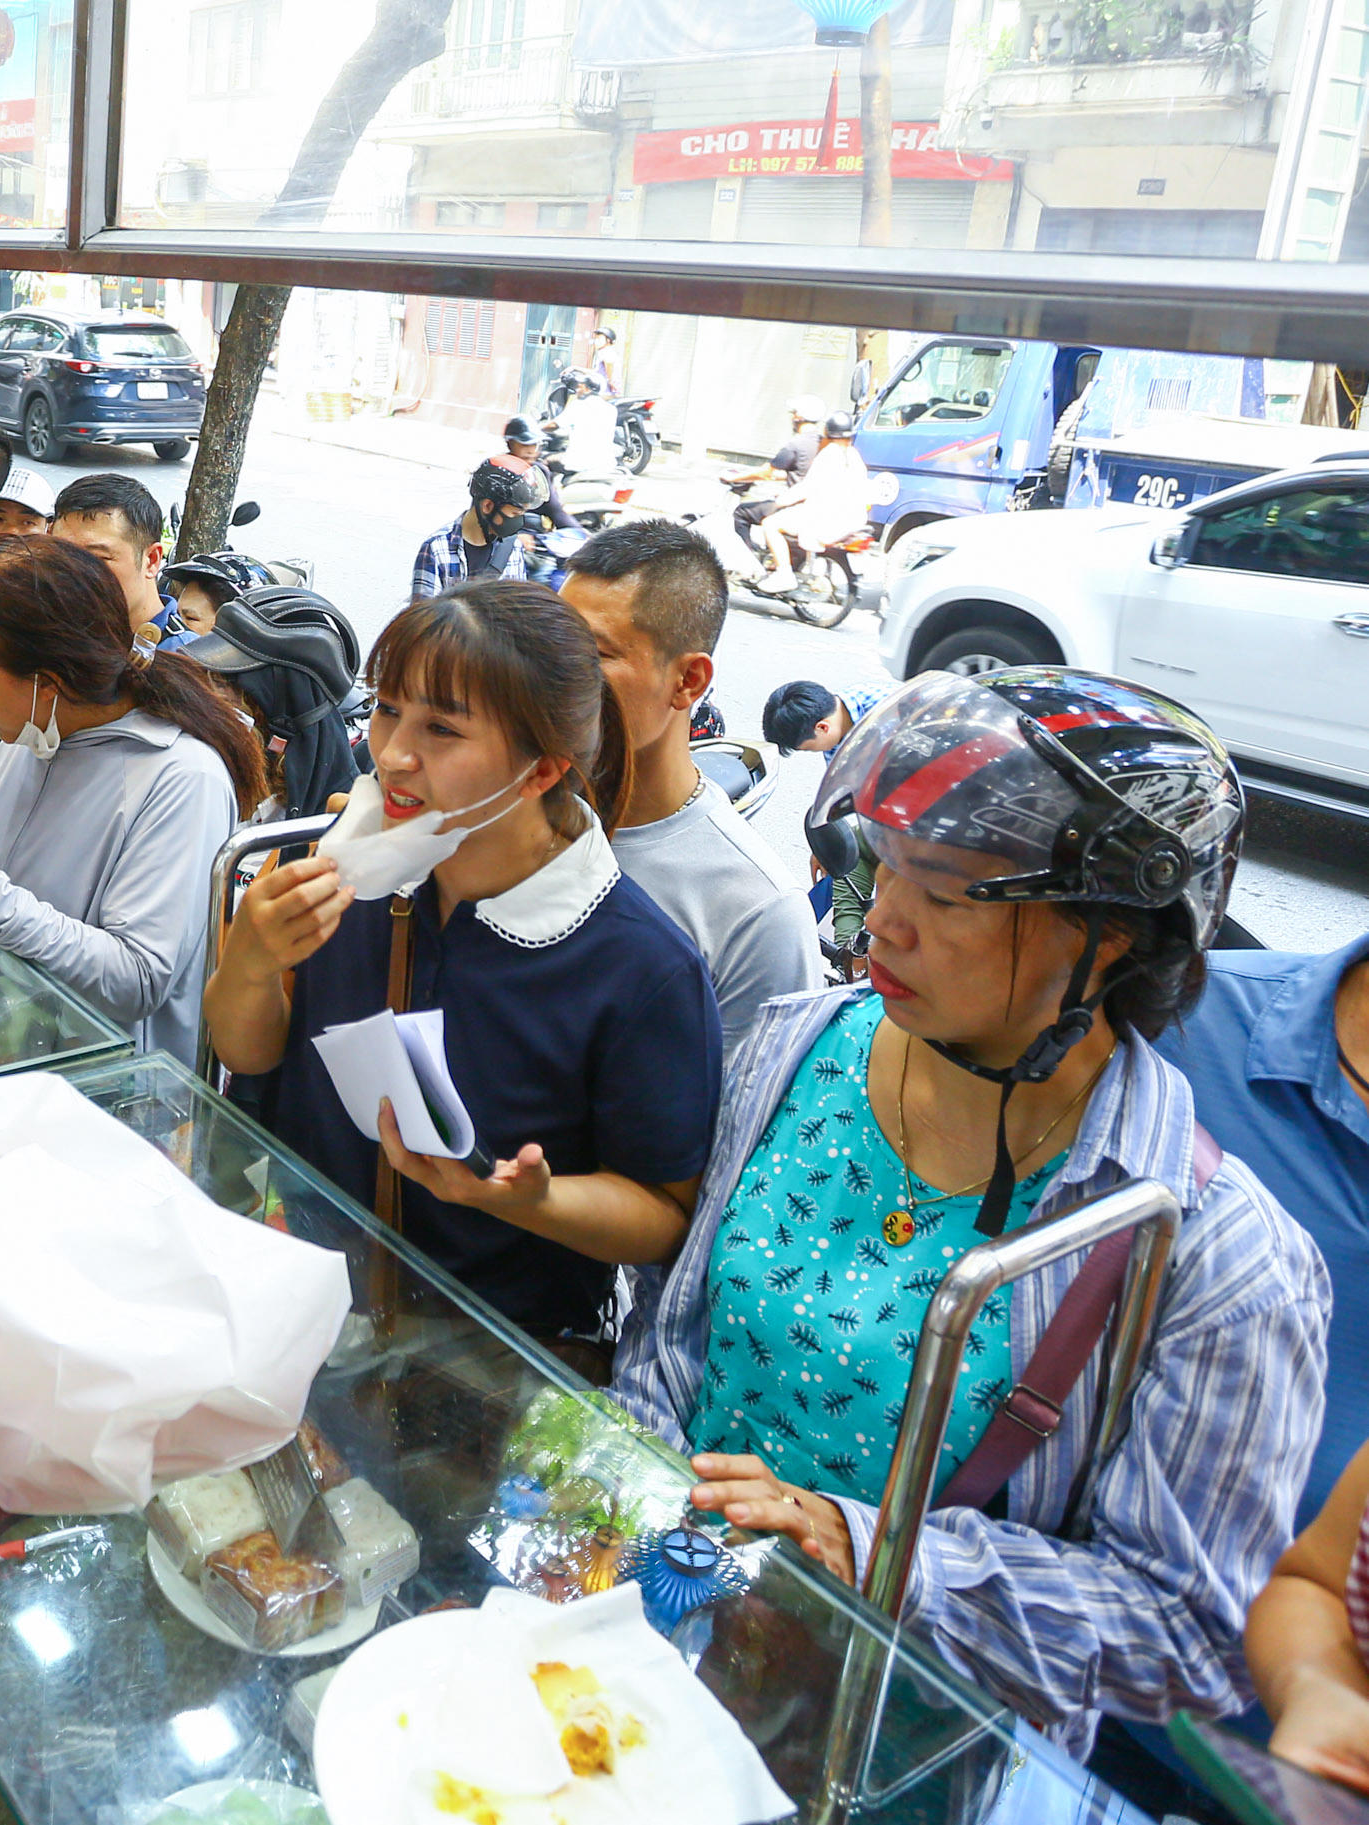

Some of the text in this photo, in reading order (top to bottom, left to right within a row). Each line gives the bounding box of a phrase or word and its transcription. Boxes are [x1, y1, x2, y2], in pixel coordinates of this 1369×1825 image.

[681, 130, 750, 156] CHO
[760, 122, 851, 151] THUÊ
[728, 158, 758, 172] LH:
